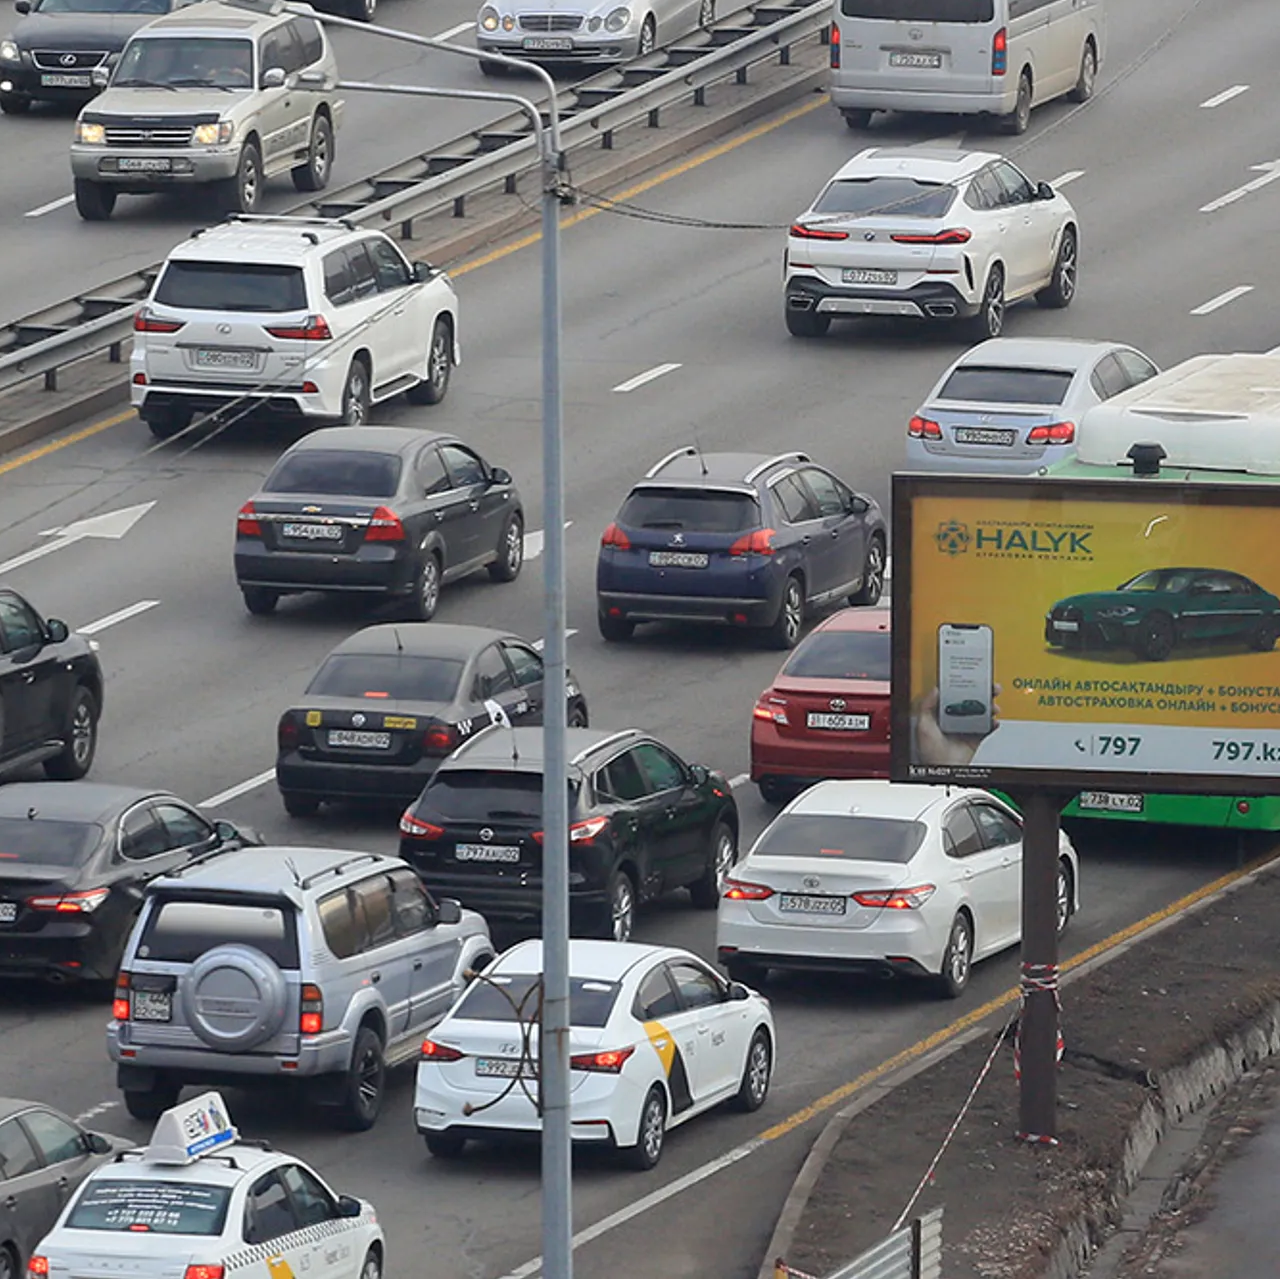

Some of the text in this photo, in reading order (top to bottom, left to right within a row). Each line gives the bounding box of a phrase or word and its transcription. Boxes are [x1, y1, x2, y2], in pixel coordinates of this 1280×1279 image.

[976, 529, 1092, 553] HALYK
[1012, 677, 1071, 691] ОНЛАЙН
[1074, 681, 1204, 697] АВТОСАҚТАНДЫРУ
[1037, 695, 1154, 709] АВТОСТРАХОВКА
[1157, 698, 1216, 712] ОНЛАЙН
[1098, 736, 1142, 757] 797
